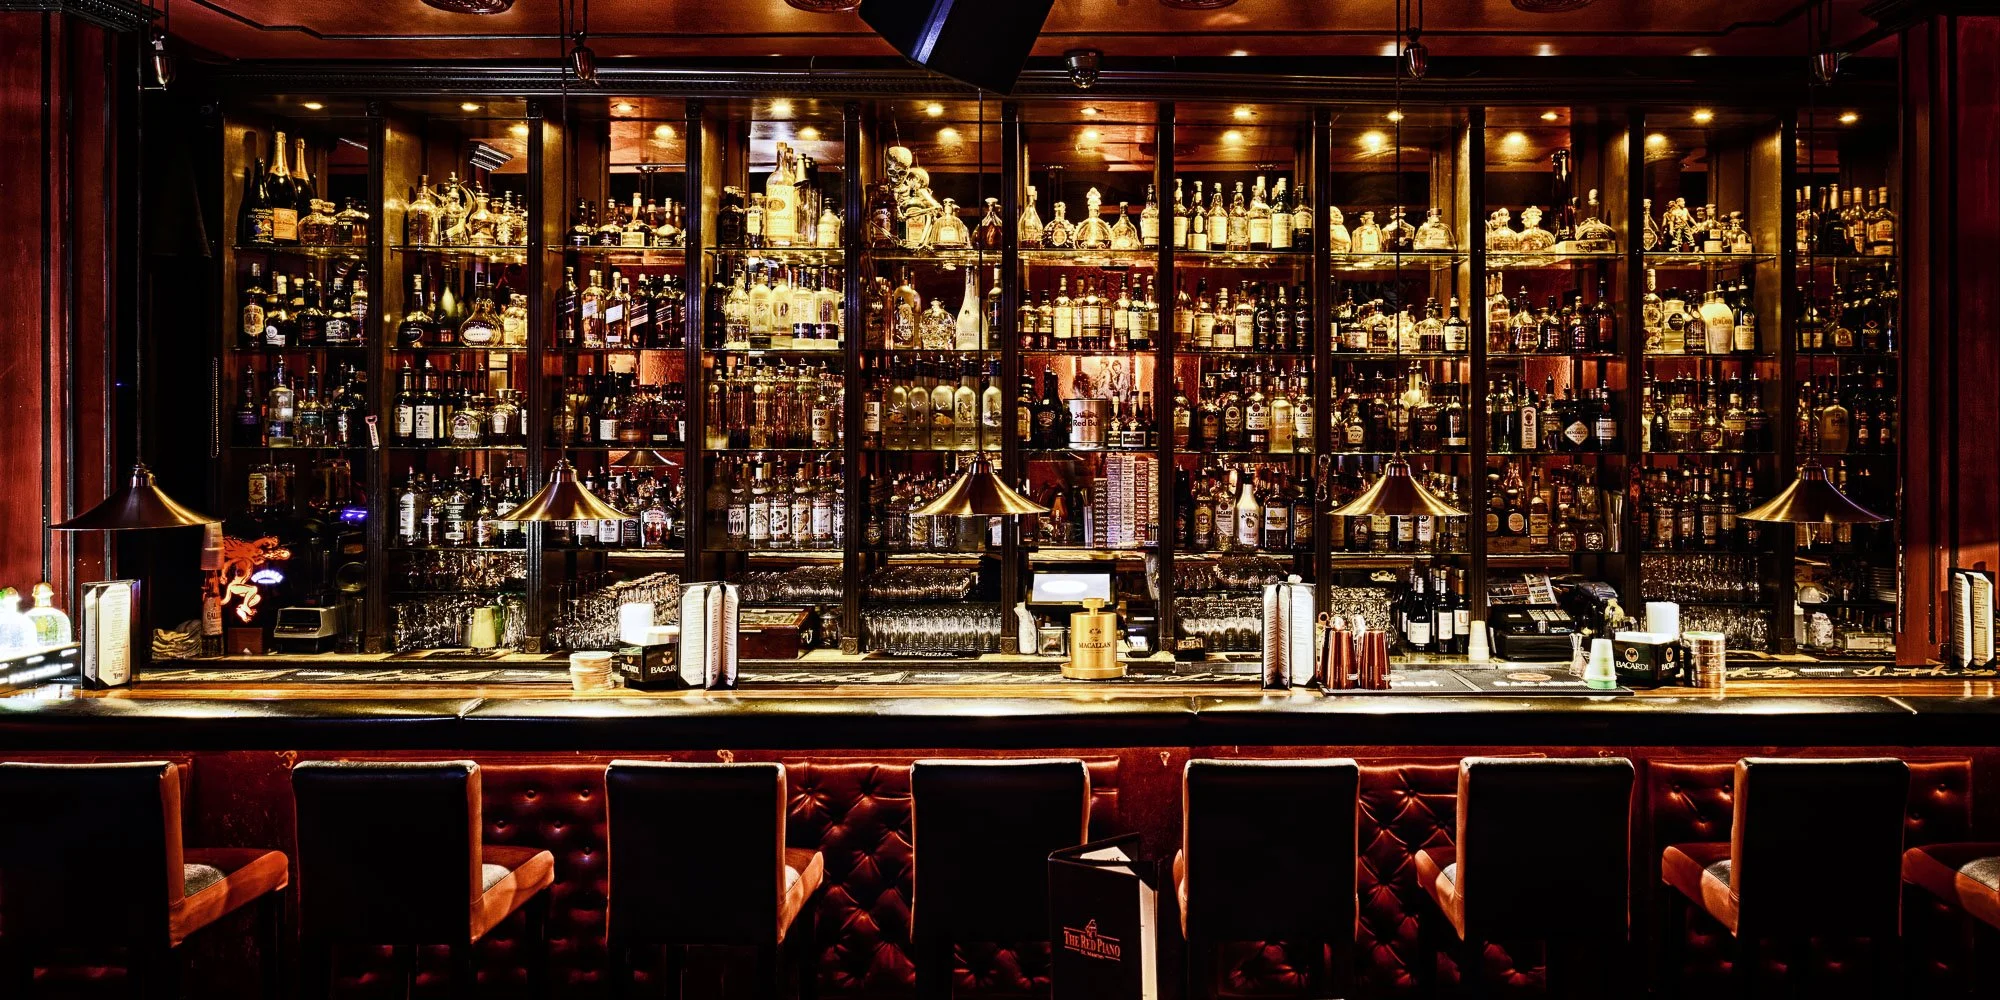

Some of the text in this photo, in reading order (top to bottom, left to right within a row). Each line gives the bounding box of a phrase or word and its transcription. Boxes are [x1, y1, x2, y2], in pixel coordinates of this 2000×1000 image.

[1073, 418, 1087, 427] Red
[650, 664, 678, 674] BACAR
[1615, 660, 1650, 671] BACARDI
[1063, 930, 1121, 958] THE RED PIANO
